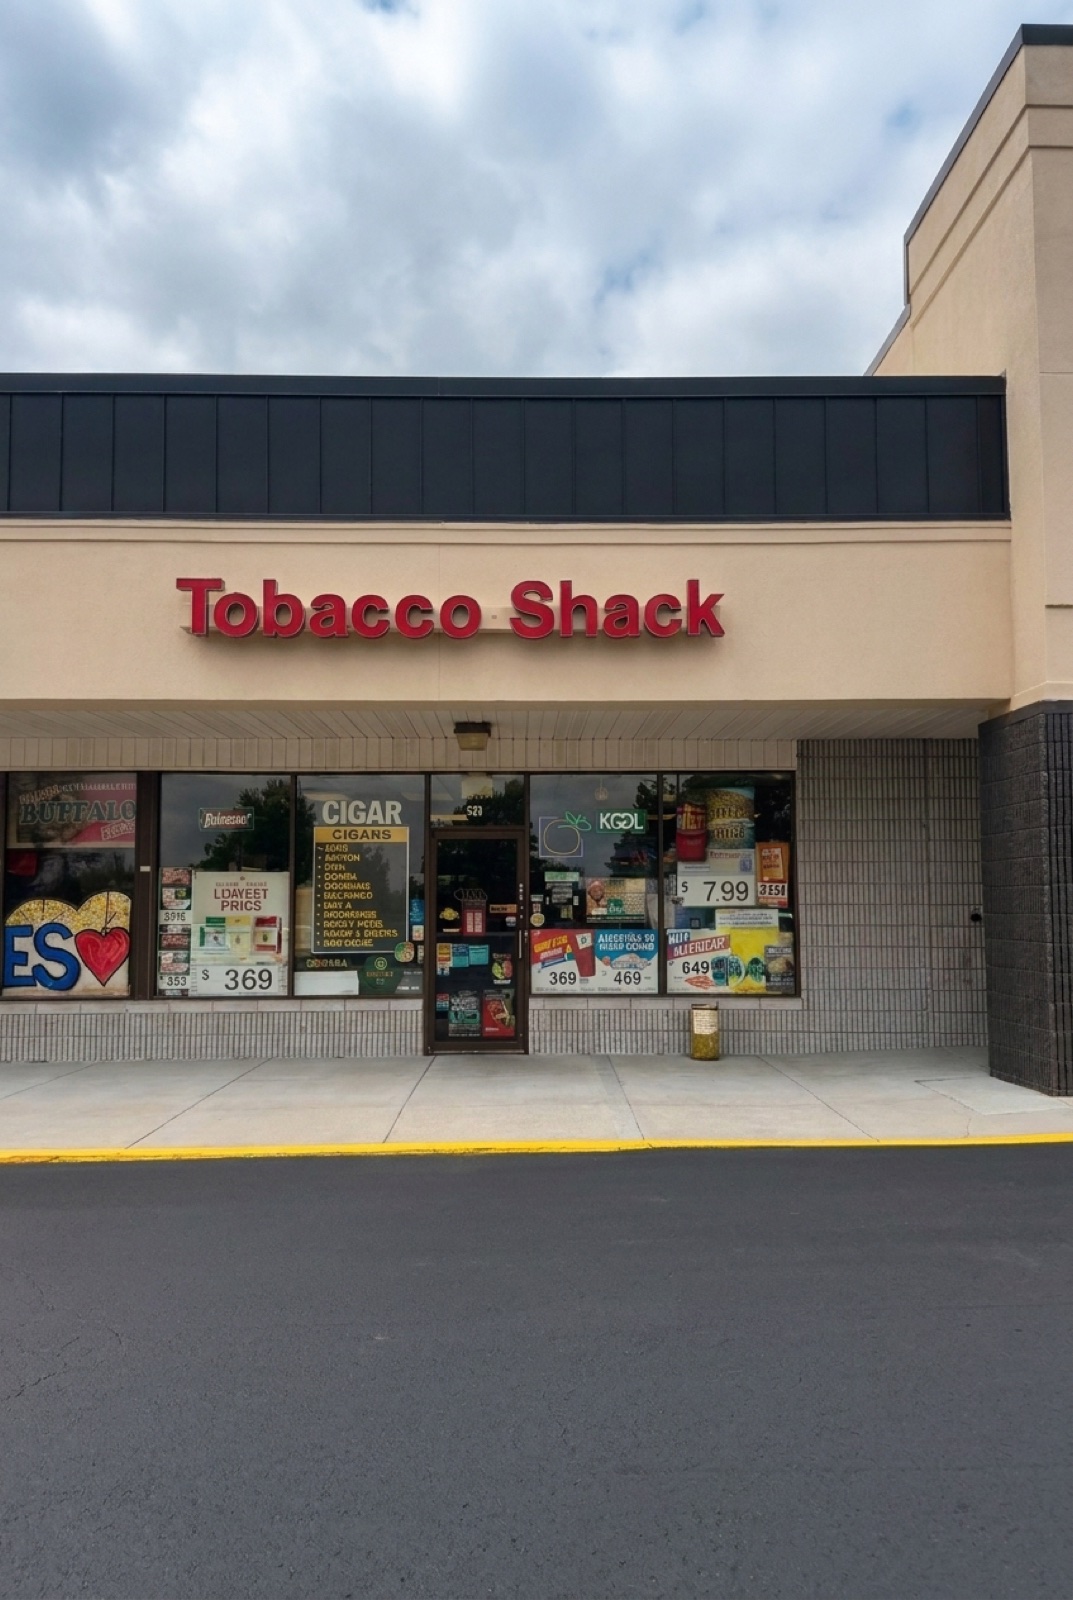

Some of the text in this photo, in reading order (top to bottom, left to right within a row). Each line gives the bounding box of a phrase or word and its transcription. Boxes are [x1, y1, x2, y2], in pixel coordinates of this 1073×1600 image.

[176, 577, 726, 639] Tobacco Shack
[322, 800, 402, 825] CIGAR
[703, 880, 749, 902] 7.99
[613, 971, 641, 985] 469
[682, 960, 710, 974] 649
[224, 968, 273, 991] 369
[549, 971, 577, 986] 369
